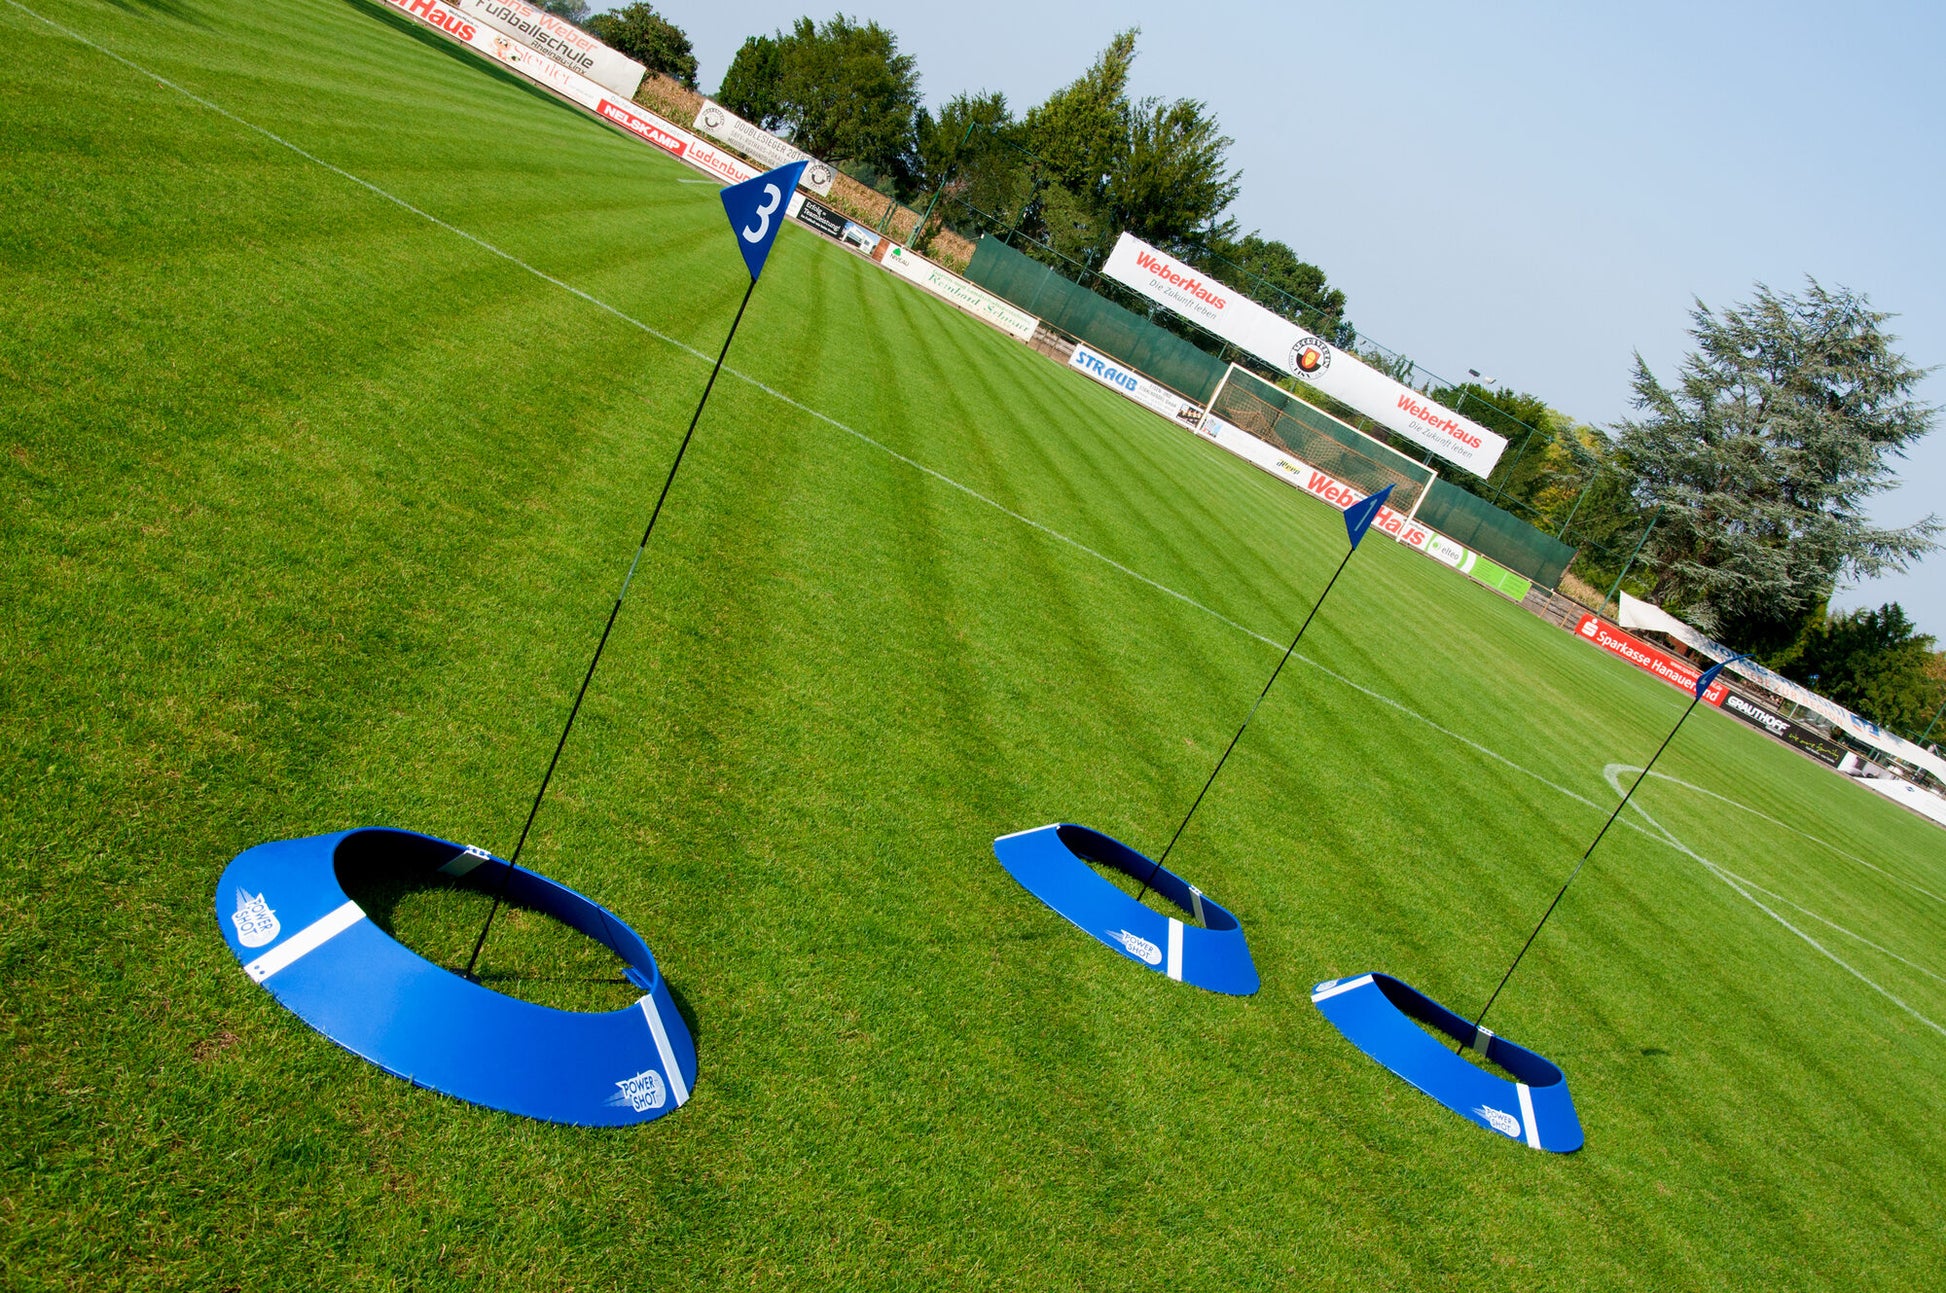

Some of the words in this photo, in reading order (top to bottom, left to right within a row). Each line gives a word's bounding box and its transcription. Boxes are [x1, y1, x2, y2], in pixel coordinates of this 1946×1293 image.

[391, 0, 476, 41] Haus
[536, 13, 599, 54] Weber
[603, 103, 680, 152] NELSKAMP
[743, 183, 782, 243] 3
[1136, 251, 1227, 310] WeberHaus
[1150, 279, 1164, 292] Die
[1163, 286, 1195, 309] Zukunft
[1194, 304, 1217, 320] leben
[1076, 350, 1138, 393] STRAUB
[1397, 394, 1483, 449] WeberHaus
[1409, 421, 1423, 434] Die
[1421, 428, 1453, 450] Zukunft
[1449, 443, 1473, 459] leben
[1596, 631, 1650, 667] Sparkasse
[1651, 659, 1719, 702] Hanauernd
[1726, 694, 1790, 733] GRAUTHOFF
[234, 911, 259, 935] SHOT
[248, 898, 273, 932] POWER
[1124, 933, 1154, 952] POWER
[1127, 943, 1151, 959] SHOT
[621, 1075, 655, 1096] POWER
[633, 1090, 657, 1110] SHOT
[1486, 1108, 1512, 1125] POWER
[1491, 1118, 1512, 1132] SHOT
